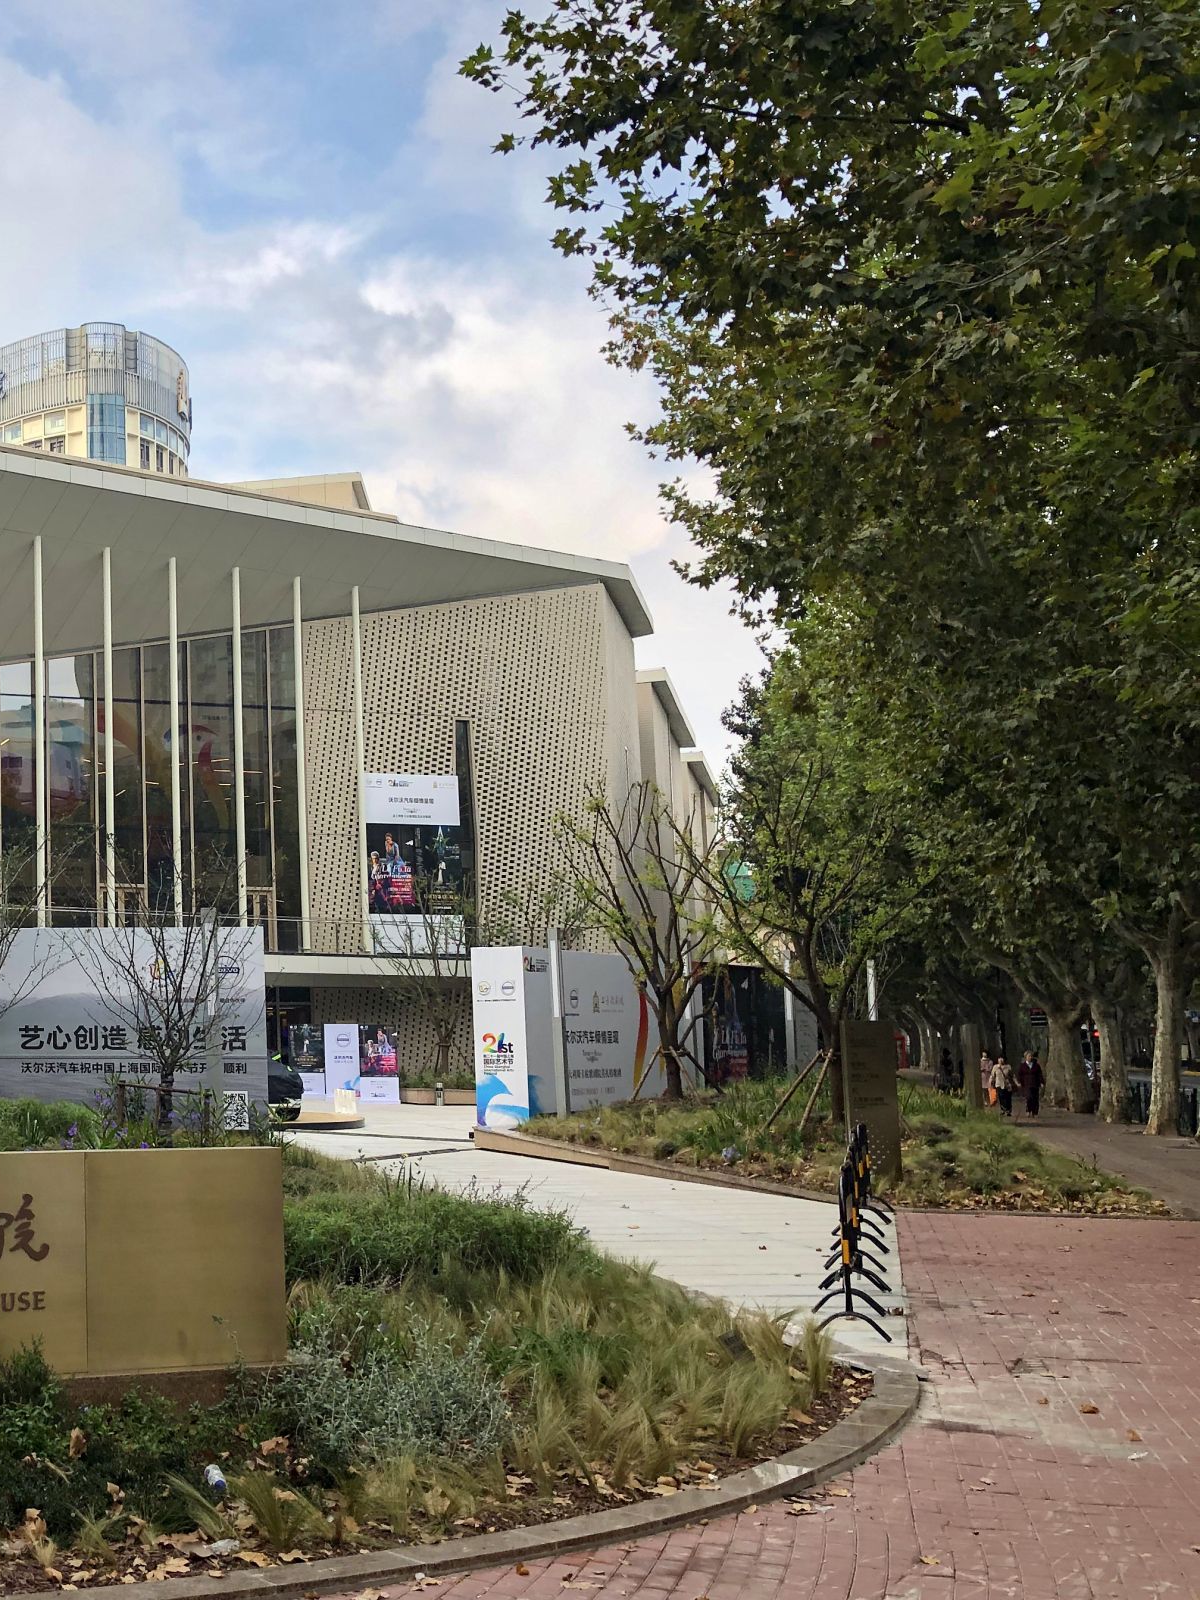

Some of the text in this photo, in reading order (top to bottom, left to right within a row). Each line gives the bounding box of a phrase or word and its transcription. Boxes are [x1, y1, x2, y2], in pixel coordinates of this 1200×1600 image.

[18, 1025, 127, 1051] 艺心创造
[482, 1032, 513, 1053] 21st
[21, 1062, 247, 1074] 沃尔沃汽车祝中国上海国际术节开顺利
